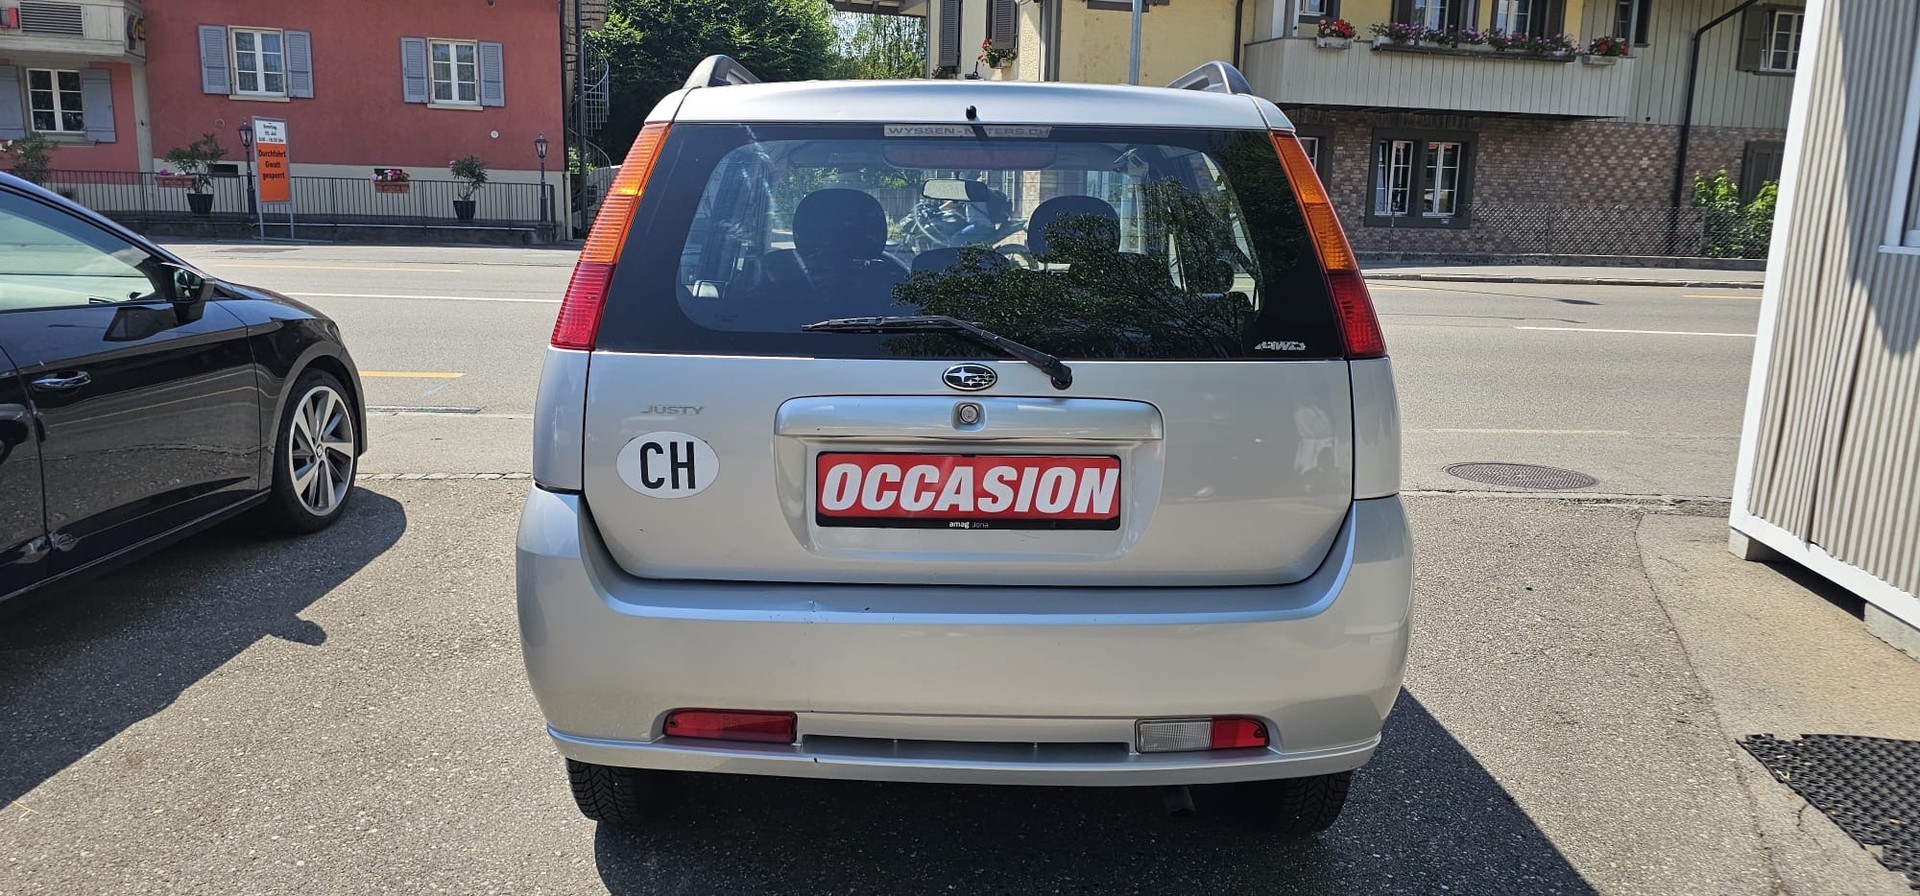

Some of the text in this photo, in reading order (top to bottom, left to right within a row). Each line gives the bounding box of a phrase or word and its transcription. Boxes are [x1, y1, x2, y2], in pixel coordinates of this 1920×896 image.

[258, 150, 286, 158] Durchfahrt
[640, 441, 696, 490] CH
[821, 463, 1120, 514] OCCASION
[948, 521, 970, 529] amag
